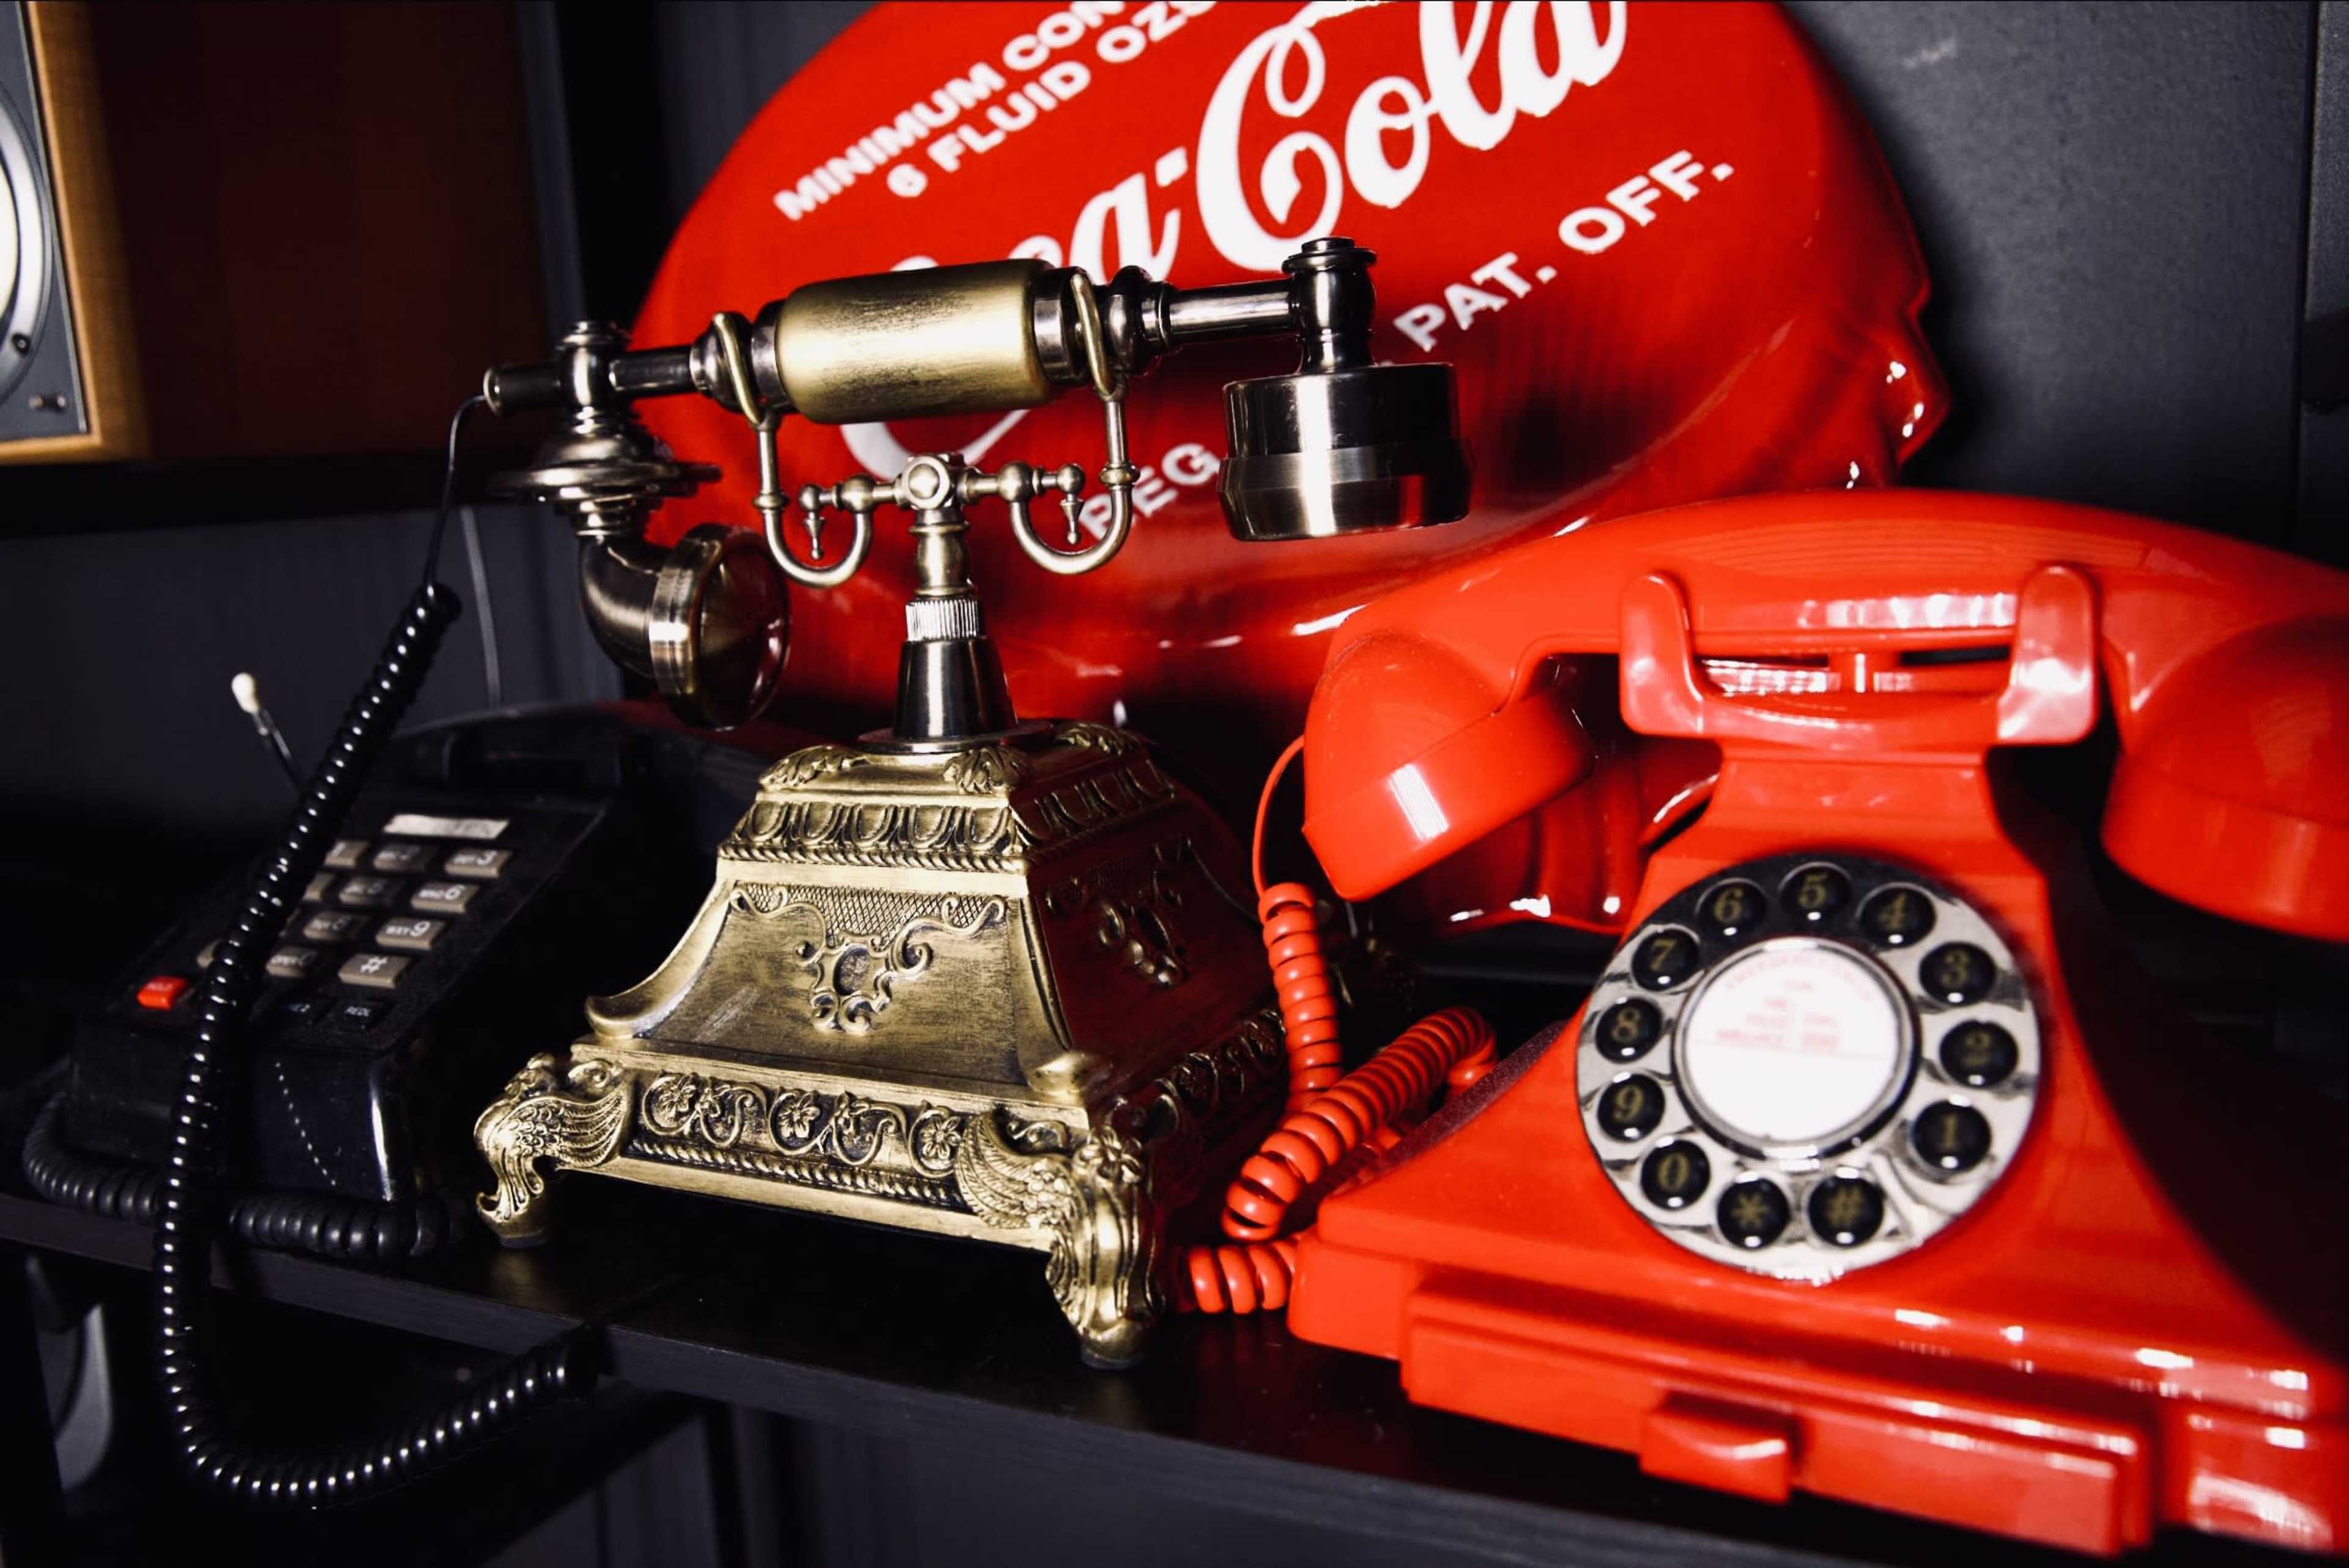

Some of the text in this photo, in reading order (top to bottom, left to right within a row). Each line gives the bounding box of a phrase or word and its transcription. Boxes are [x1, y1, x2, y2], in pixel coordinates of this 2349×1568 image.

[773, 62, 1007, 221] MINIMUM
[887, 163, 927, 198] 6
[926, 60, 1091, 173] FLUID
[1393, 252, 1557, 352] PAT.
[1558, 150, 1735, 254] OFF.
[1715, 888, 1742, 920] 6
[1800, 875, 1825, 905] 5
[409, 920, 431, 937] 9
[1881, 901, 1907, 930] 4
[1650, 937, 1679, 971] 7
[1943, 952, 1969, 982] 3
[1612, 1008, 1641, 1040] 8
[1615, 1088, 1643, 1122] 9
[1939, 1120, 1957, 1150] 1
[1658, 1159, 1686, 1191] 0
